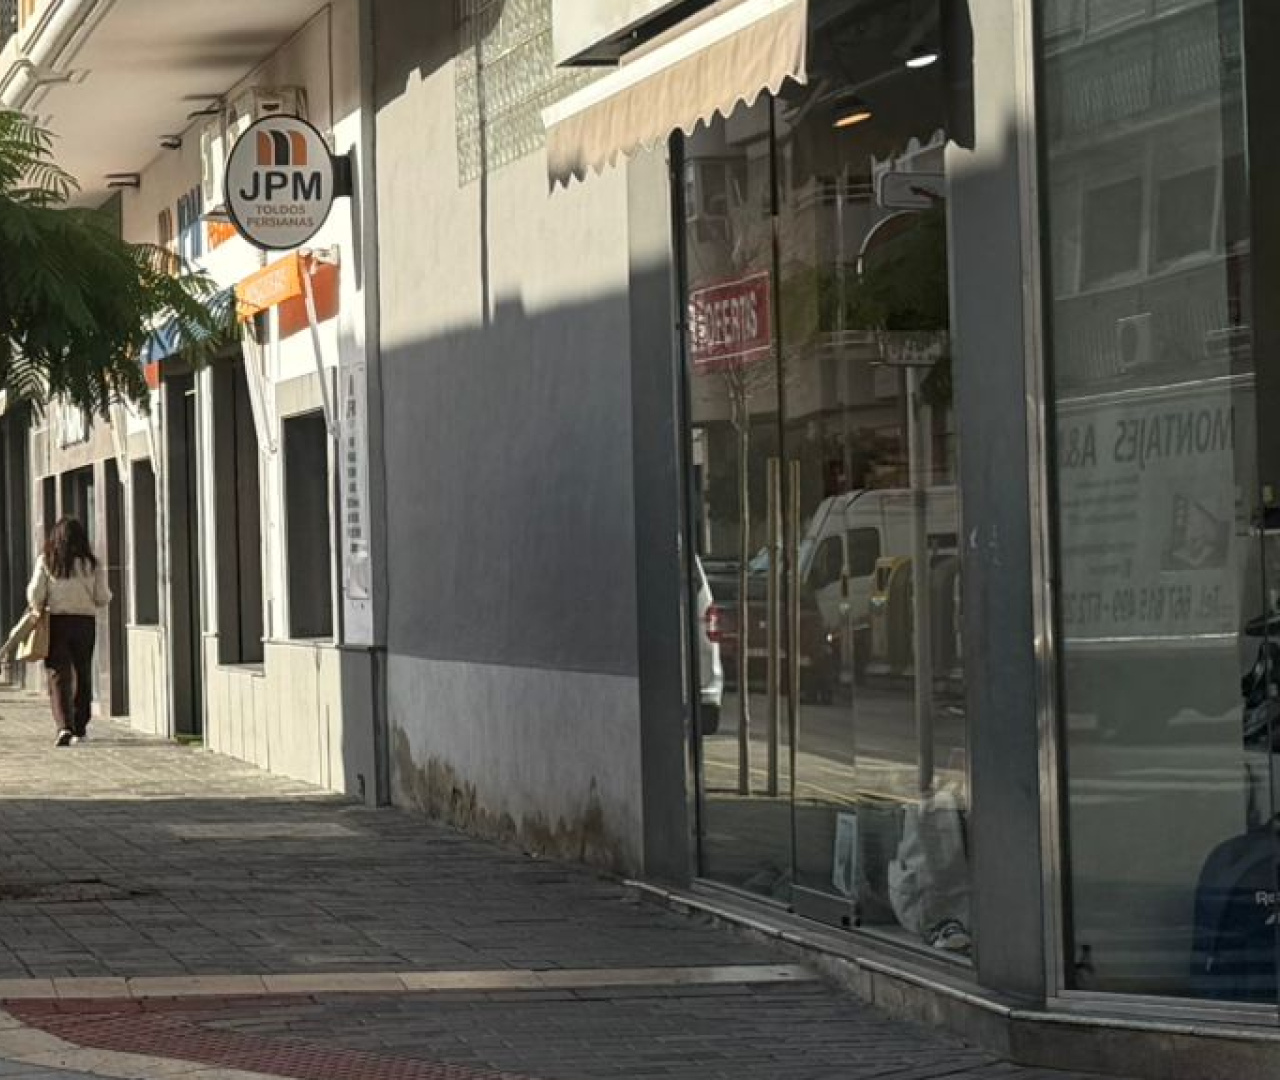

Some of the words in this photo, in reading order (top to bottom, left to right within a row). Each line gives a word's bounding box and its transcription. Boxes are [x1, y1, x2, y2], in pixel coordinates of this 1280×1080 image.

[239, 170, 323, 201] JPM
[255, 204, 306, 215] TOLDOS
[246, 216, 315, 227] PERSIANAS
